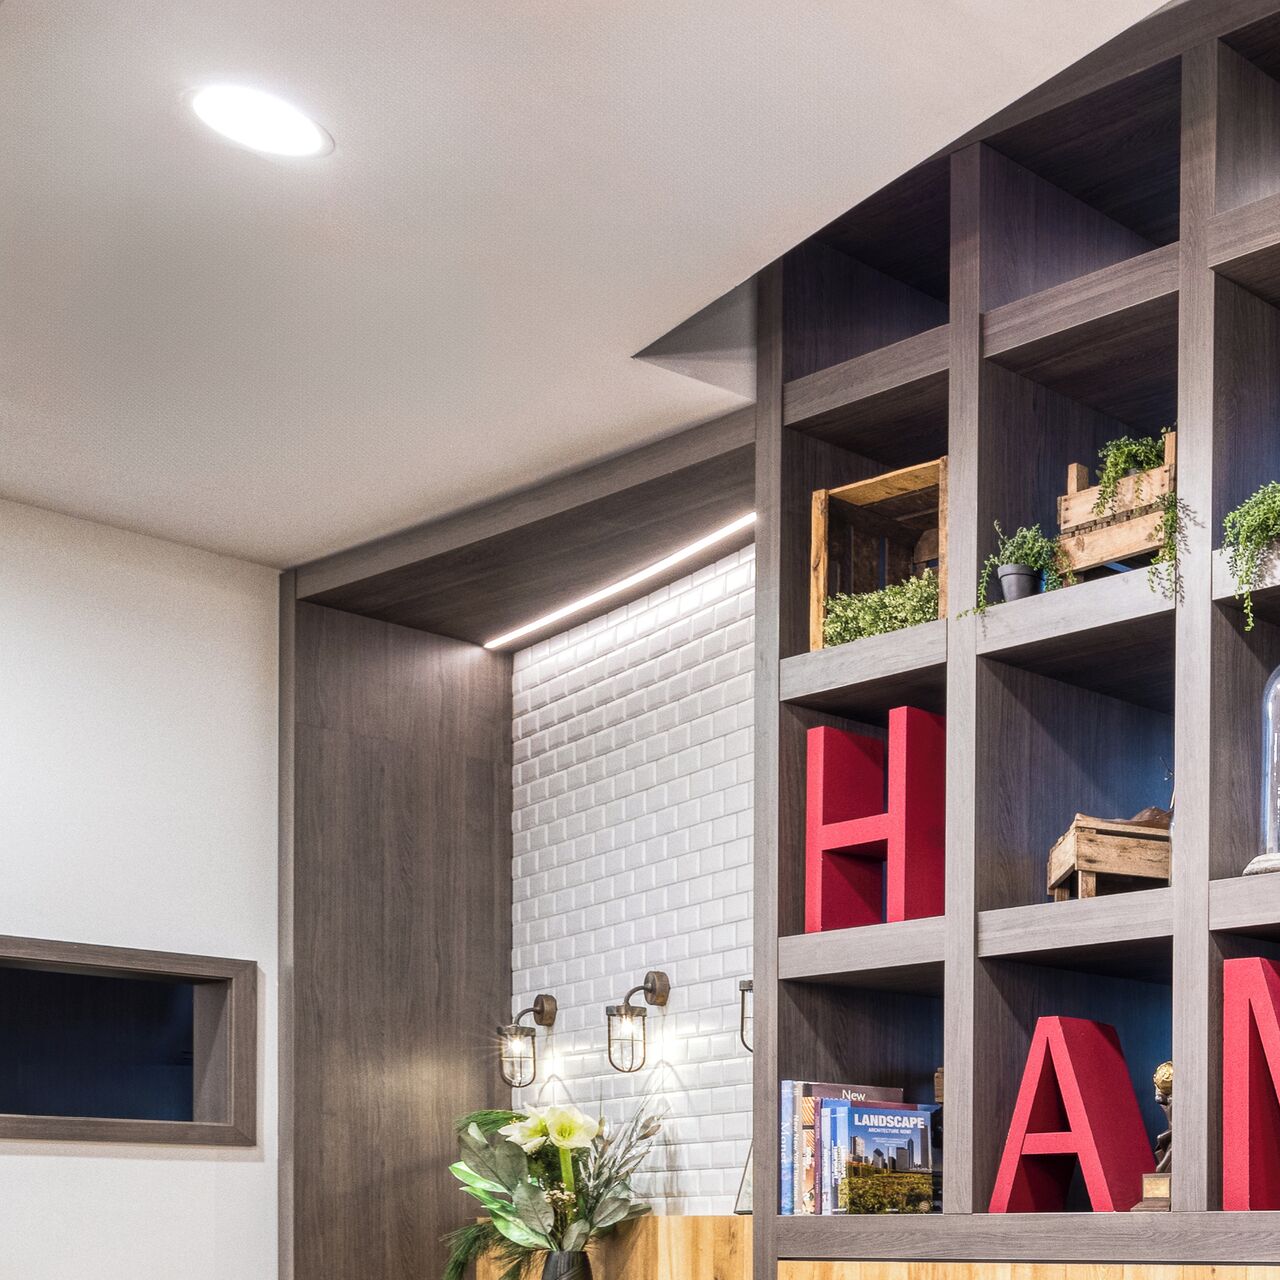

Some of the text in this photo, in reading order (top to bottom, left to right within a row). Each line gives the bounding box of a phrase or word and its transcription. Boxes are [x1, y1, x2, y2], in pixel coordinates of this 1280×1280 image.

[842, 1089, 866, 1101] New
[854, 1114, 925, 1128] LANDSCAPE
[780, 1121, 790, 1165] Monet
